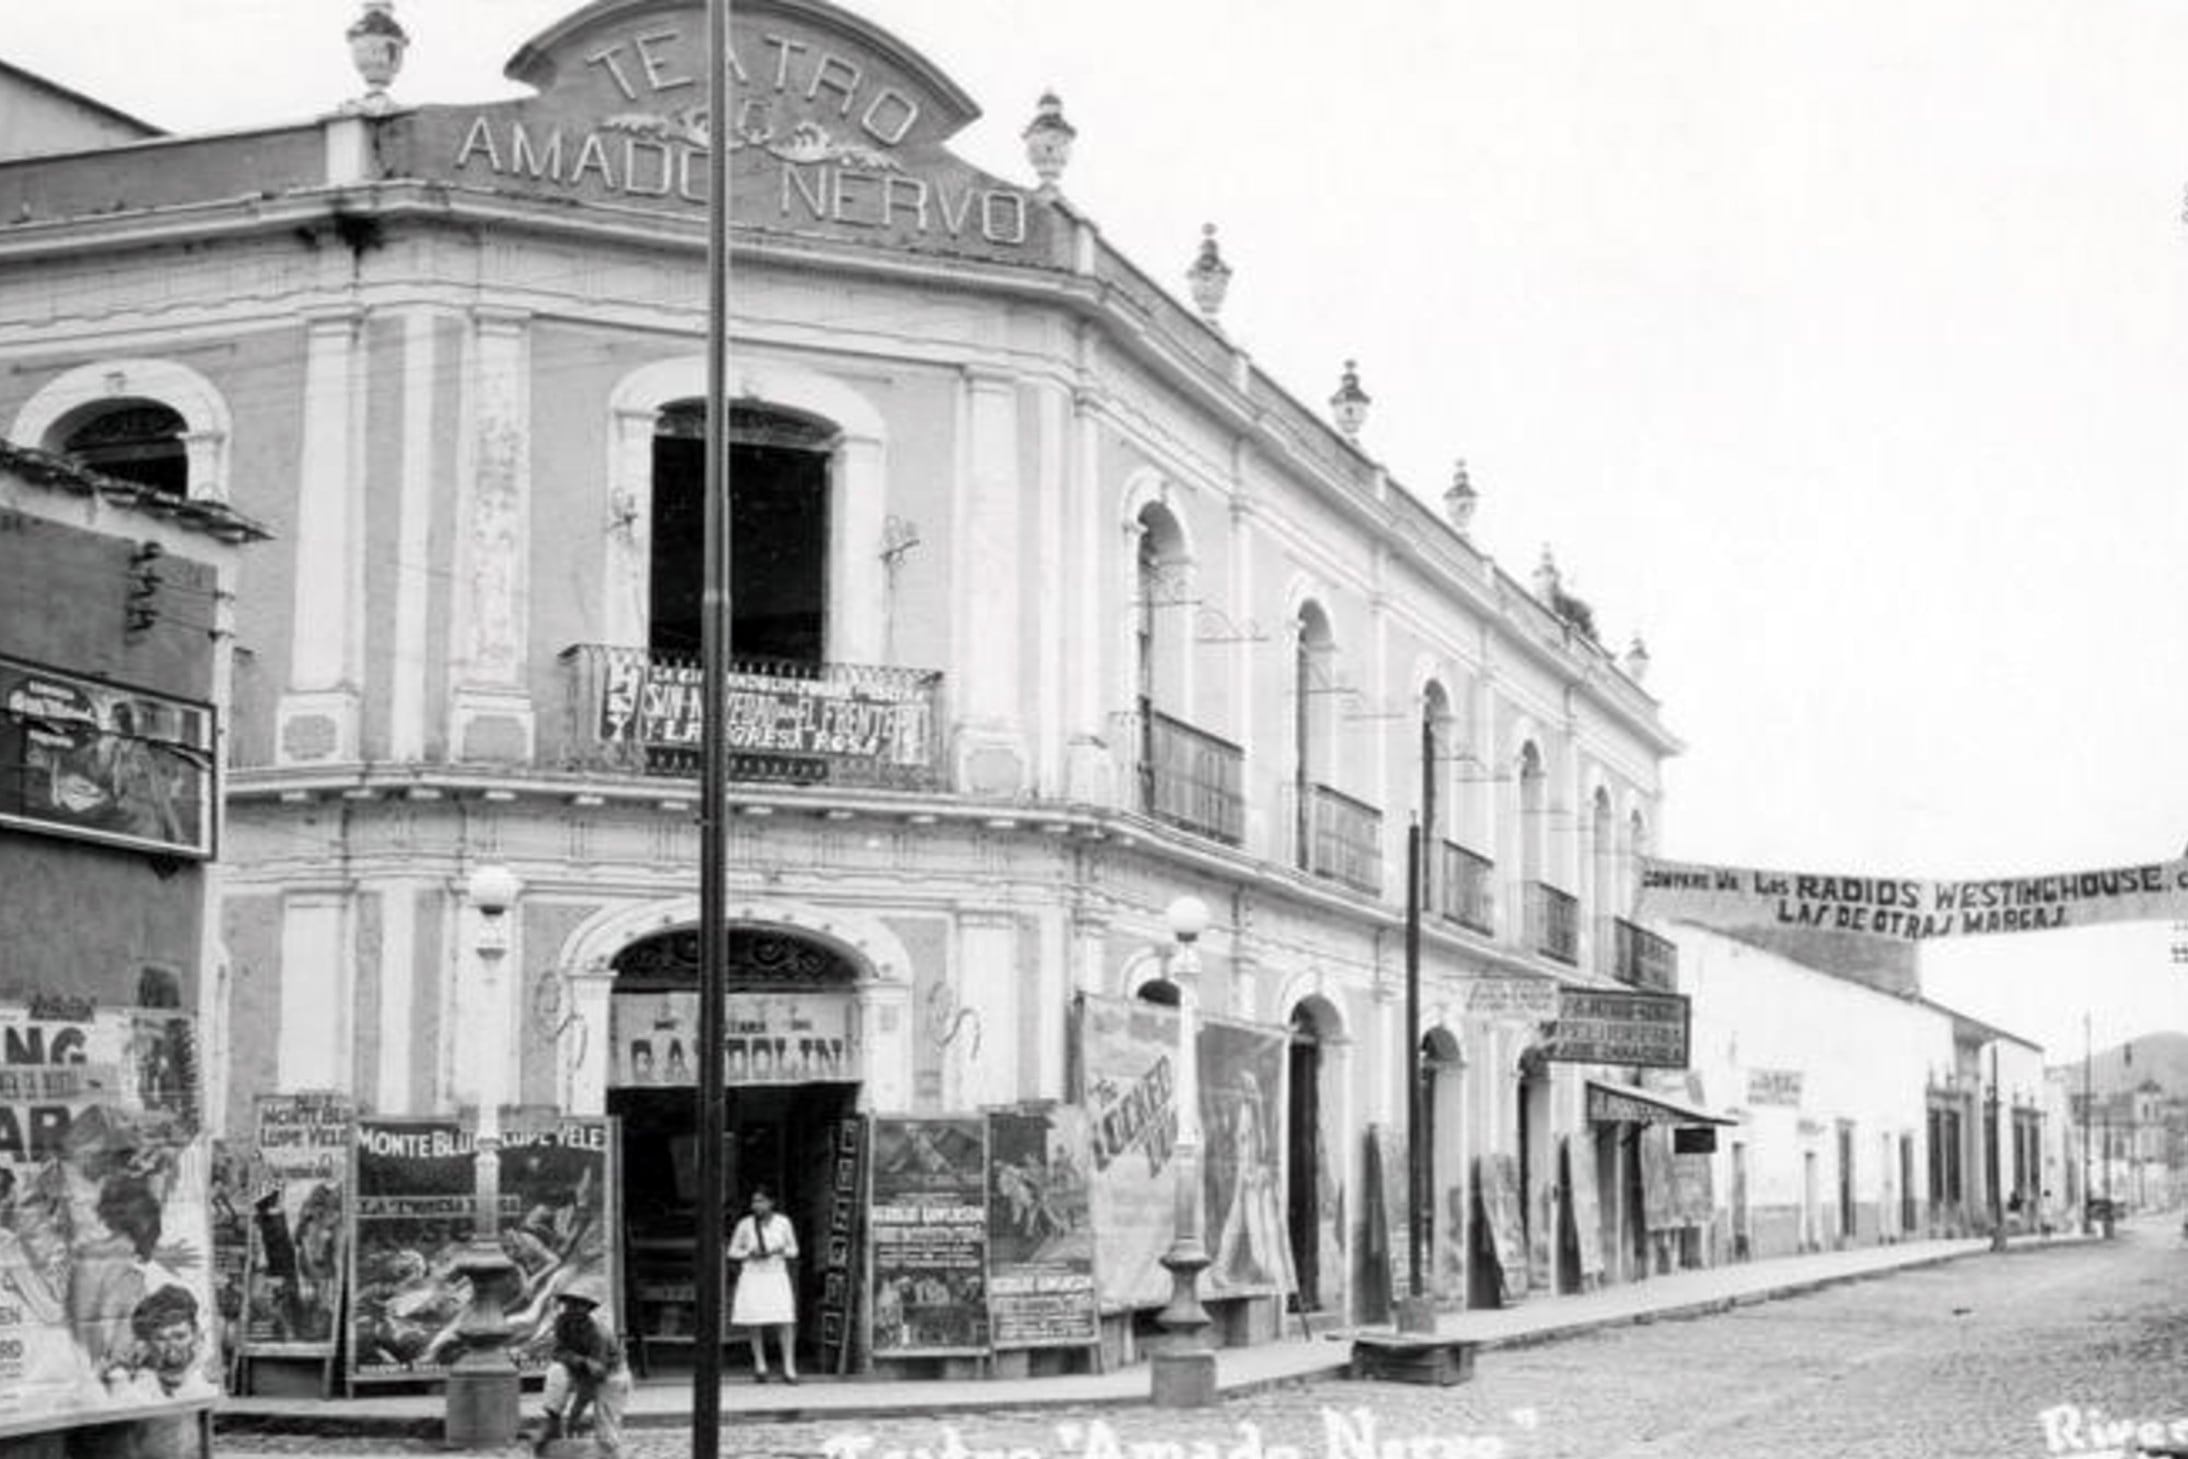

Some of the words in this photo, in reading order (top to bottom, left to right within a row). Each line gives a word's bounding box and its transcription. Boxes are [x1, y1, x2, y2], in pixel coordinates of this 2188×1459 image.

[455, 115, 710, 204] AMADO
[779, 160, 1027, 245] NERVO
[1797, 874, 1920, 909] RADIOS
[1836, 904, 1868, 931] DE
[358, 1127, 429, 1159] MONTE
[431, 1130, 476, 1157] BLU
